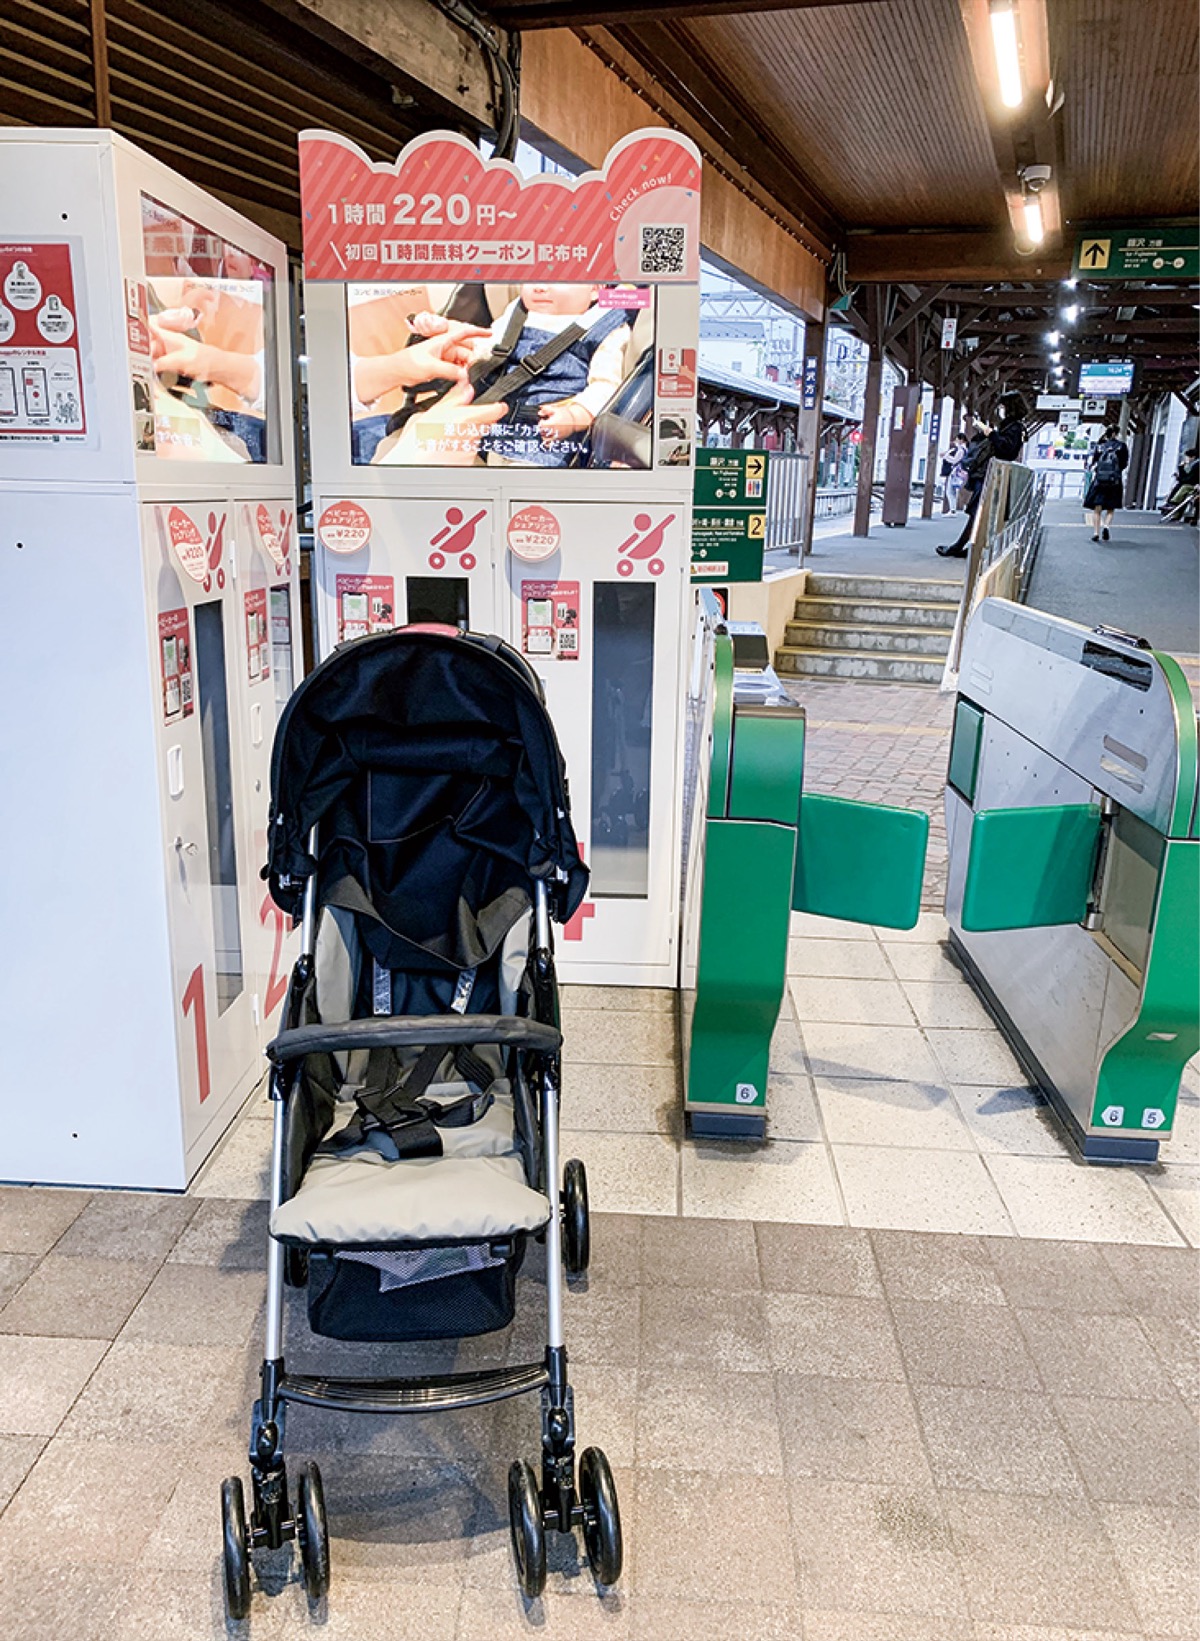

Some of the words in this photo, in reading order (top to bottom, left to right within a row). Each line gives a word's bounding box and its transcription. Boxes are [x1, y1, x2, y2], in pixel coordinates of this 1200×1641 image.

[609, 186, 641, 221] Check
[641, 172, 672, 191] now!
[345, 244, 378, 262] 初回
[538, 243, 588, 262] 配布中
[326, 509, 364, 517] ベビーカー
[514, 514, 553, 522] ベビーカー
[324, 516, 365, 524] シェアリング
[513, 521, 555, 530] シェアリング
[752, 516, 762, 535] 2
[181, 963, 210, 1104] 1
[740, 1087, 750, 1099] 6
[1110, 1110, 1119, 1122] 6
[1147, 1112, 1157, 1124] 5
